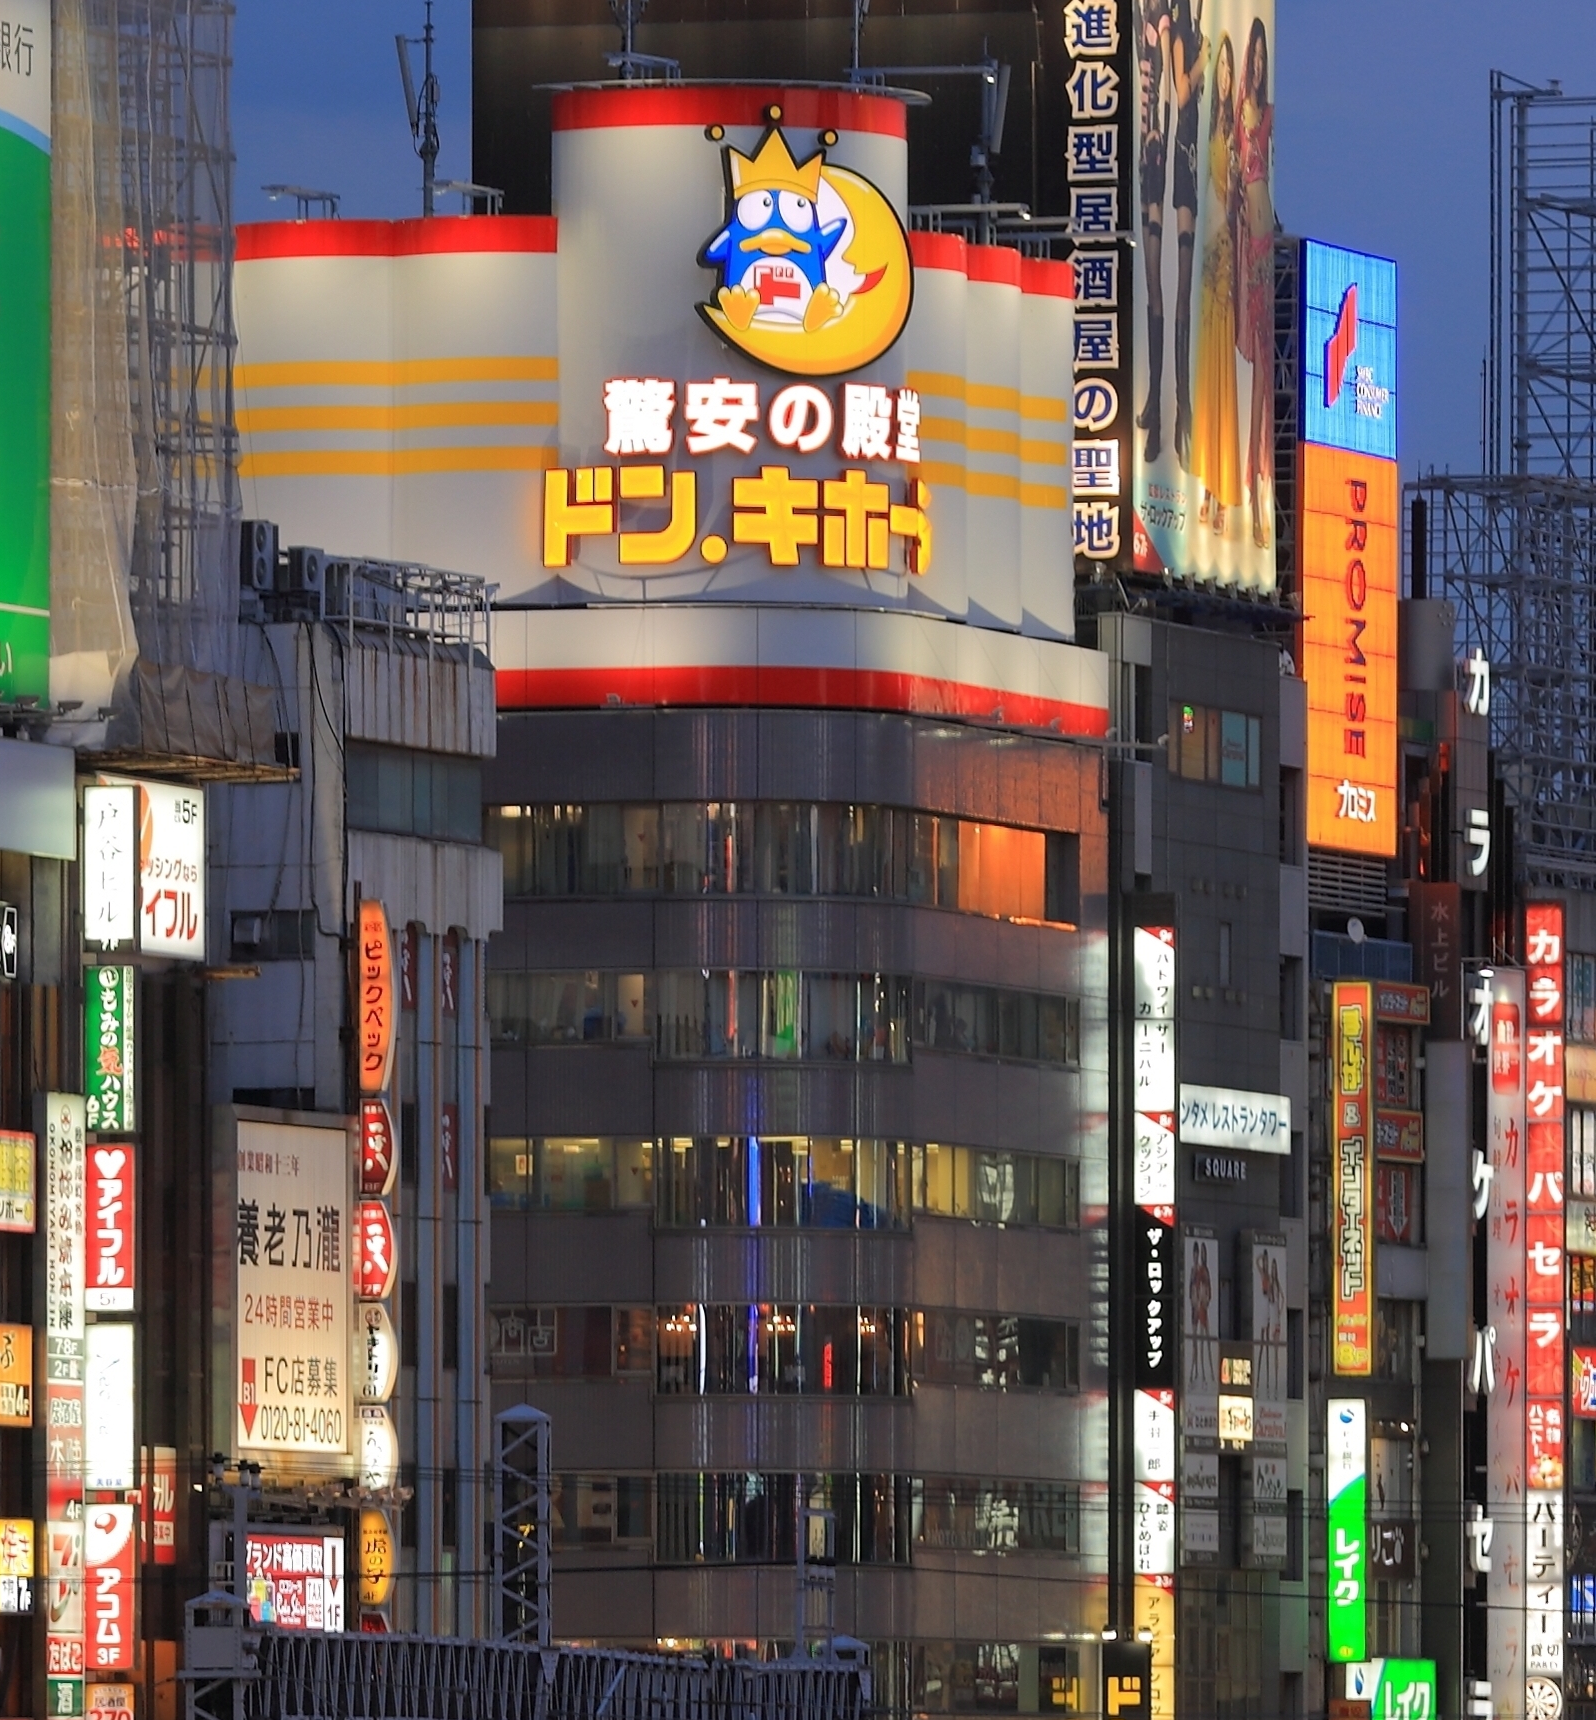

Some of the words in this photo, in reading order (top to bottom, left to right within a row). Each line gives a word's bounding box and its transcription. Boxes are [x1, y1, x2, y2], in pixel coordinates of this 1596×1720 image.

[1064, 0, 1121, 560] 進化型居酒屋の聖地
[604, 377, 922, 462] 驚安の殿堂
[1344, 479, 1368, 760] PROMISE
[182, 799, 197, 826] 5F
[1430, 902, 1449, 998] 水上ビル
[1527, 930, 1562, 1116] カラオケ
[1205, 1158, 1246, 1179] SQUARE
[97, 1178, 124, 1285] アイフル
[238, 1199, 341, 1273] 養老乃瀧
[244, 1293, 334, 1332] 24時間営業中
[243, 1381, 255, 1402] B1
[264, 1355, 338, 1397] FC店募集
[261, 1405, 342, 1443] 0120-81-4060
[67, 1500, 82, 1519] 4F
[1334, 1527, 1360, 1606] レイク
[96, 1567, 121, 1644] アコム
[327, 1604, 340, 1627] 1F
[50, 1642, 82, 1672] たばこ
[97, 1648, 120, 1665] 3F
